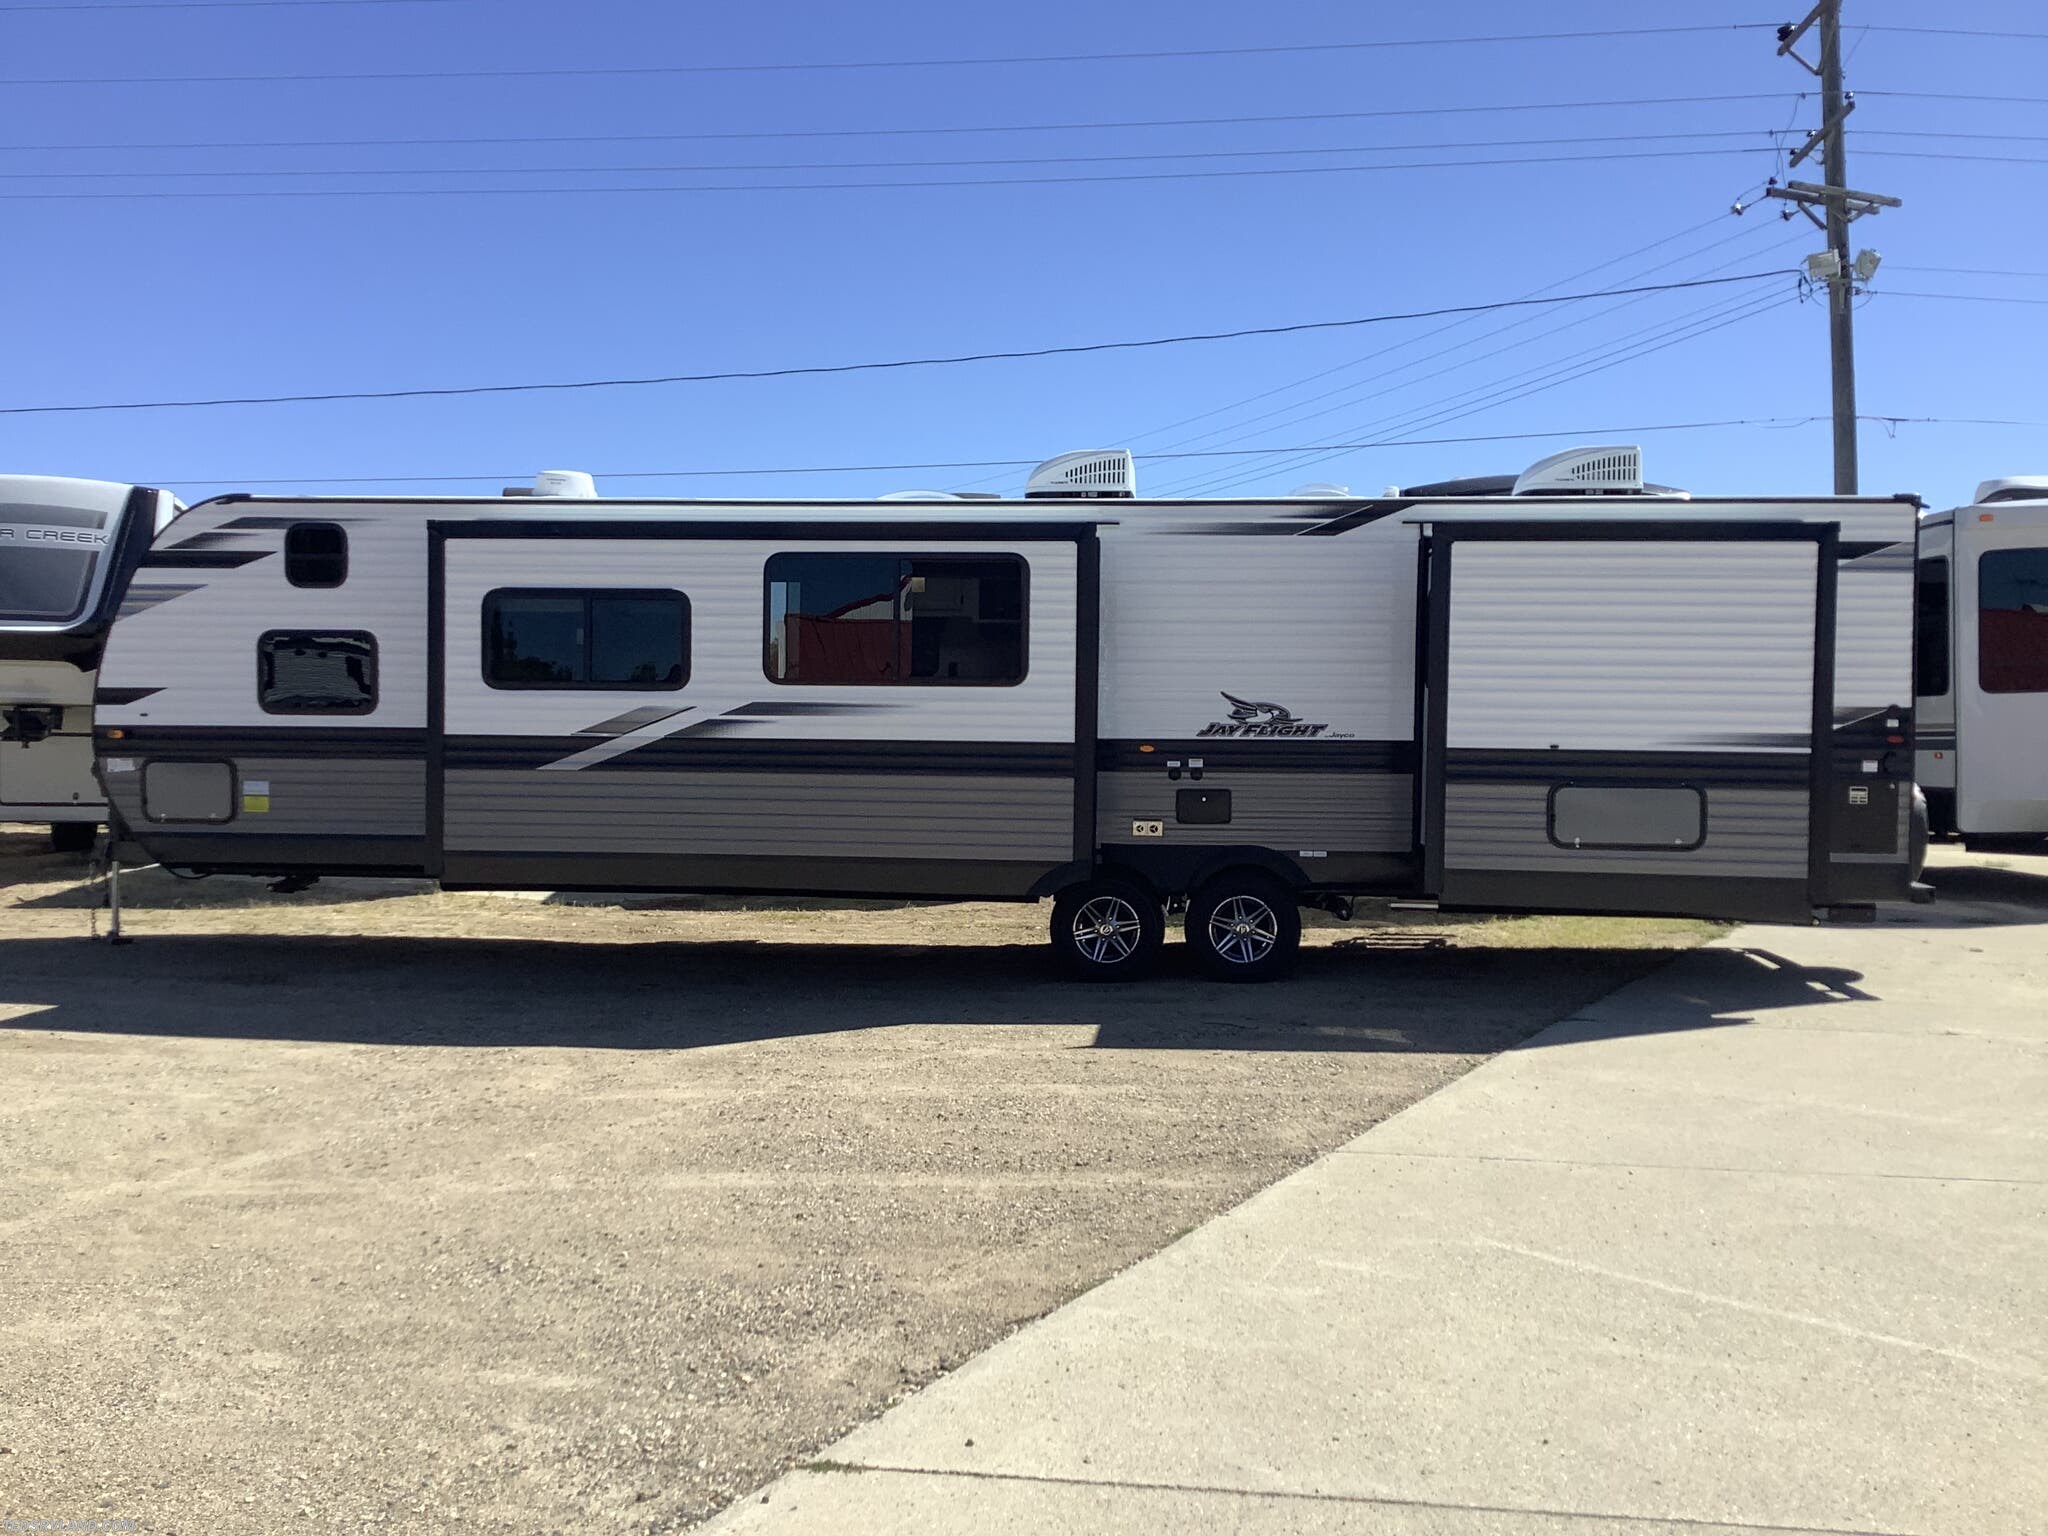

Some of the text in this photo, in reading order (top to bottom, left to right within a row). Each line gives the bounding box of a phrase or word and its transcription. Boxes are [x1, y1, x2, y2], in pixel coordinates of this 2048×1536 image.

[26, 529, 109, 545] CREEK
[1196, 722, 1328, 738] JAY FLIGHT
